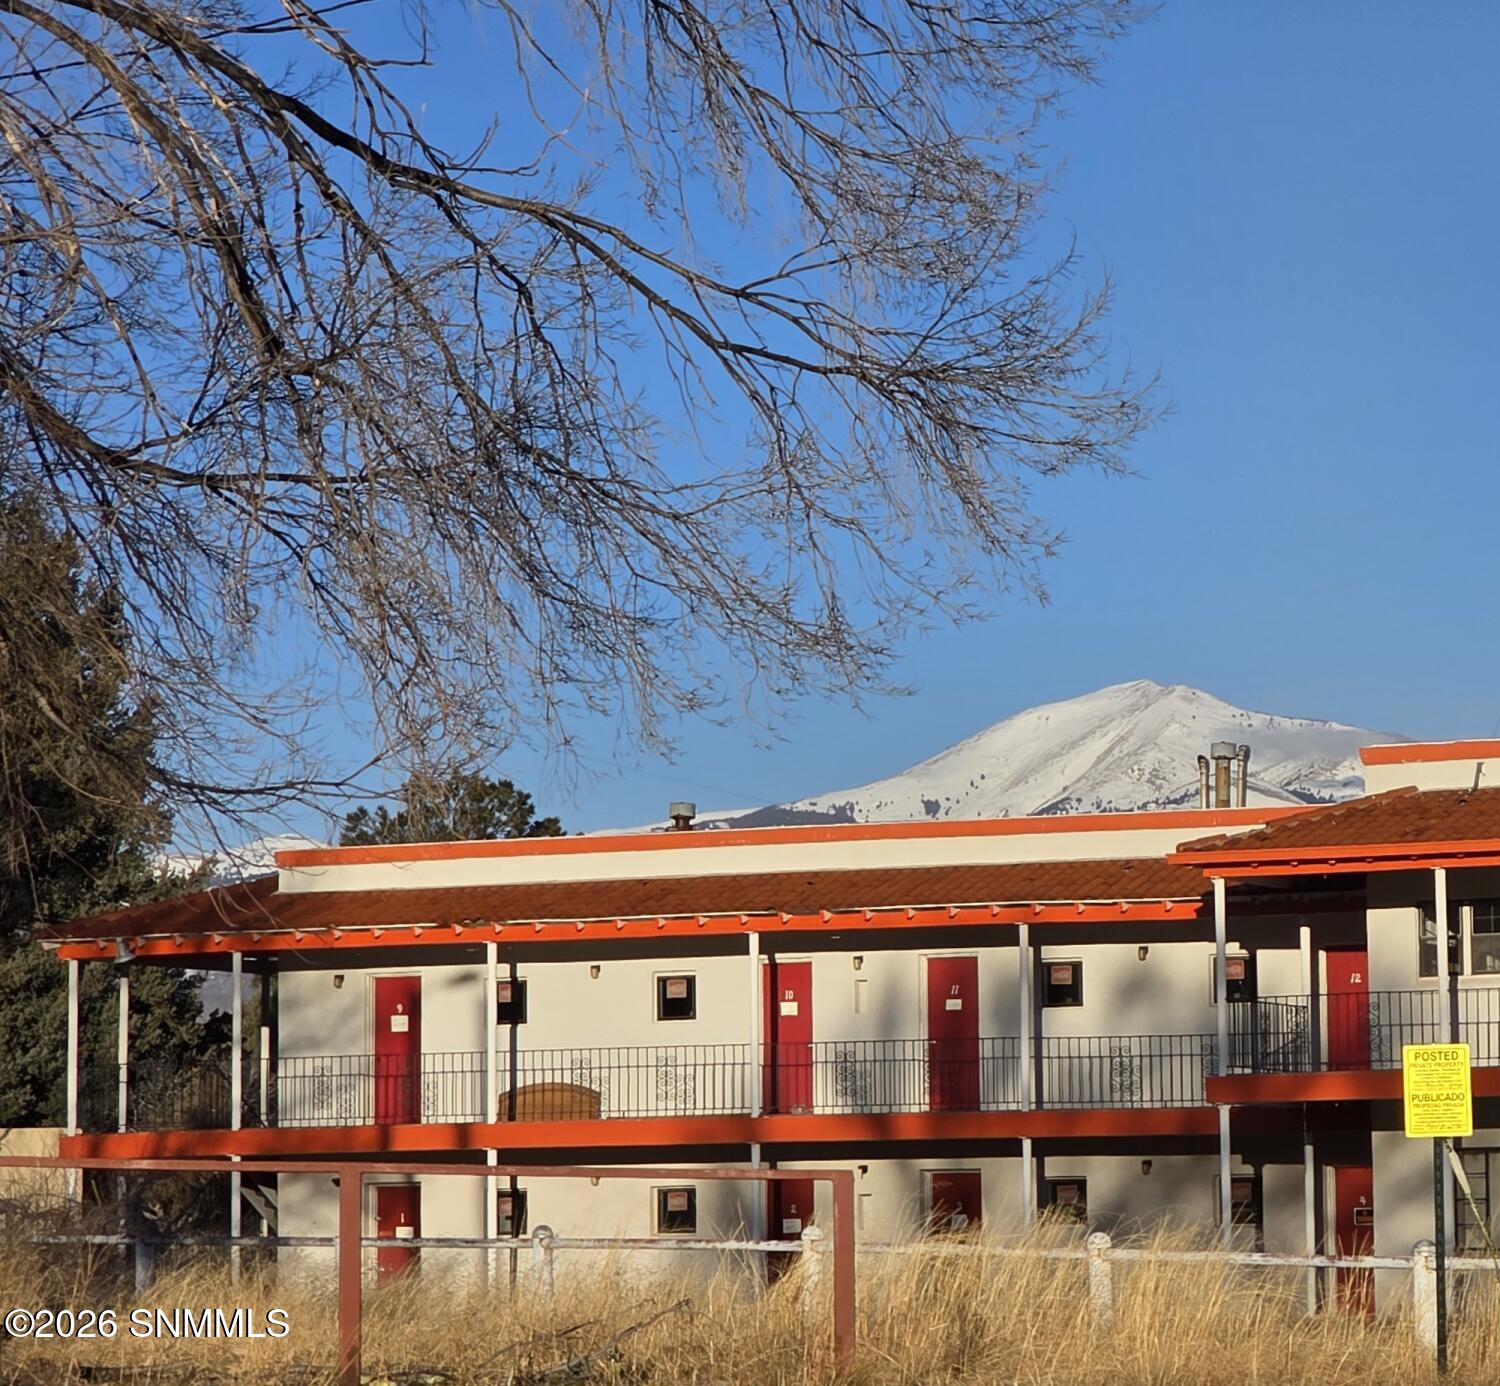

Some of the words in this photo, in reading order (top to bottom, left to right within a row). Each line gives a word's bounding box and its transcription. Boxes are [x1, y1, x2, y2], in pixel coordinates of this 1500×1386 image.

[1350, 973, 1361, 983] 12
[785, 990, 793, 1000] 10
[397, 1004, 402, 1013] 9
[1414, 1051, 1459, 1061] POSTED
[1412, 1092, 1465, 1102] PUBLICADO
